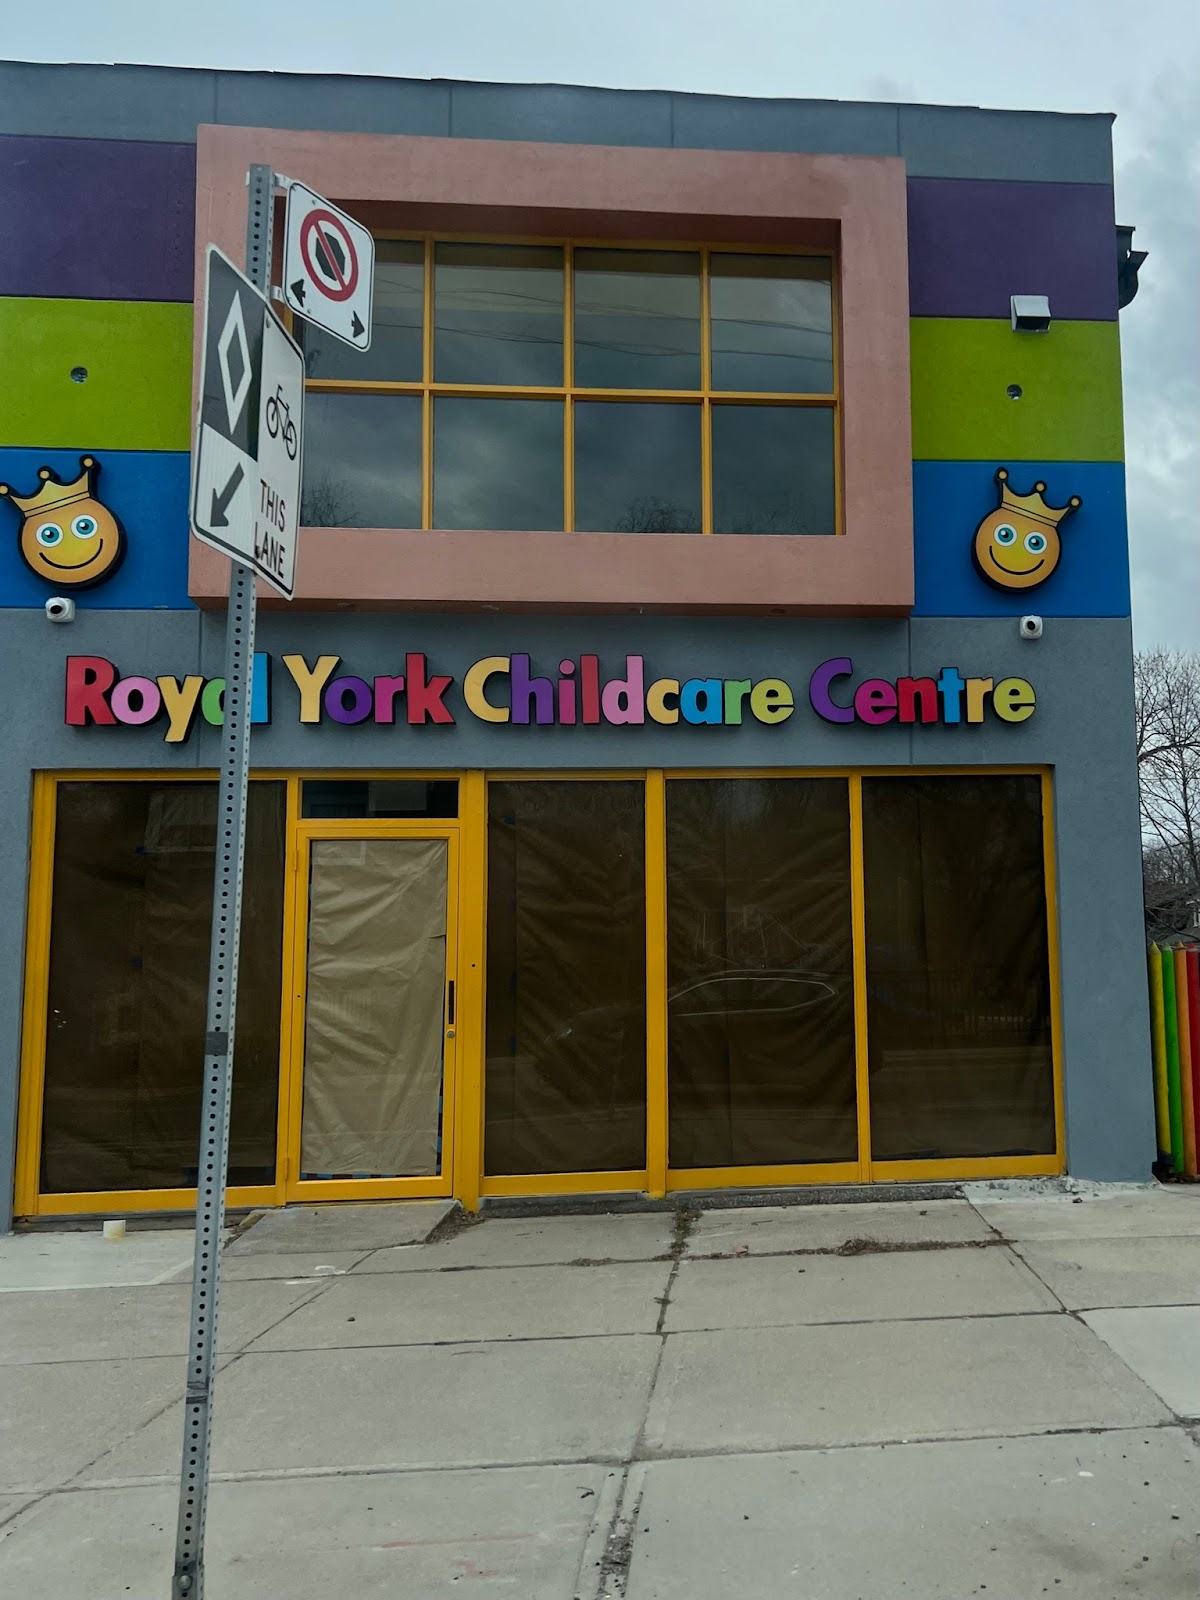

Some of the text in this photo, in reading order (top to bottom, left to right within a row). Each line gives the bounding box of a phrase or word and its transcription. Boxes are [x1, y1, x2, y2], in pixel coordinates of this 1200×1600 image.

[260, 478, 286, 533] THIS
[254, 521, 286, 579] LANE
[282, 653, 455, 726] York
[463, 653, 795, 726] Childcare
[808, 656, 1036, 726] Centre
